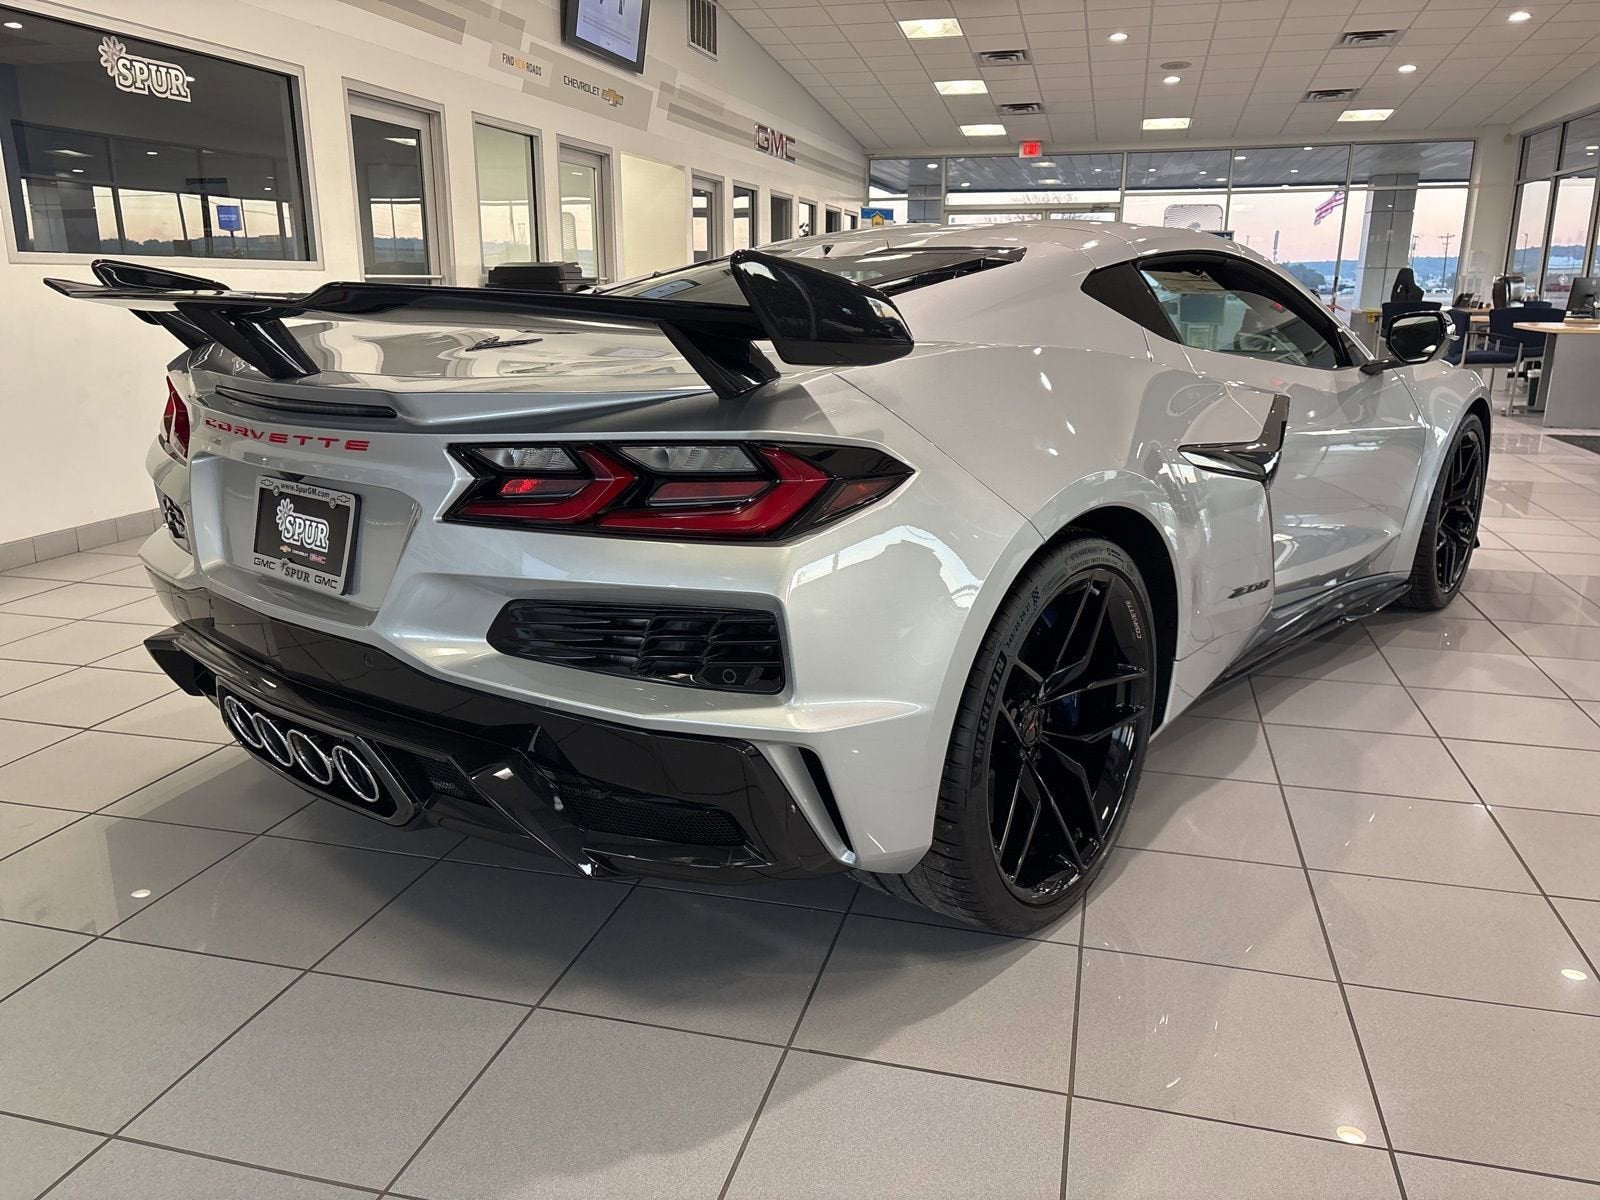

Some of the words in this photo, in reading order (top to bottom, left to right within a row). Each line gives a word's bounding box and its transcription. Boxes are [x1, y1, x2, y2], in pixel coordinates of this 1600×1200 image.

[502, 53, 515, 66] FIND
[116, 57, 189, 99] SPUR
[563, 75, 600, 97] CHEVROLET
[755, 123, 796, 163] GMC
[205, 417, 370, 451] CORVETTE
[280, 482, 330, 499] www.SpurGM.com
[283, 513, 328, 550] SPUR
[253, 557, 276, 571] GMC
[284, 565, 310, 583] SPUR
[314, 574, 338, 589] GMC
[1125, 600, 1142, 639] CORVETTE
[974, 656, 1007, 761] MICHELIN
